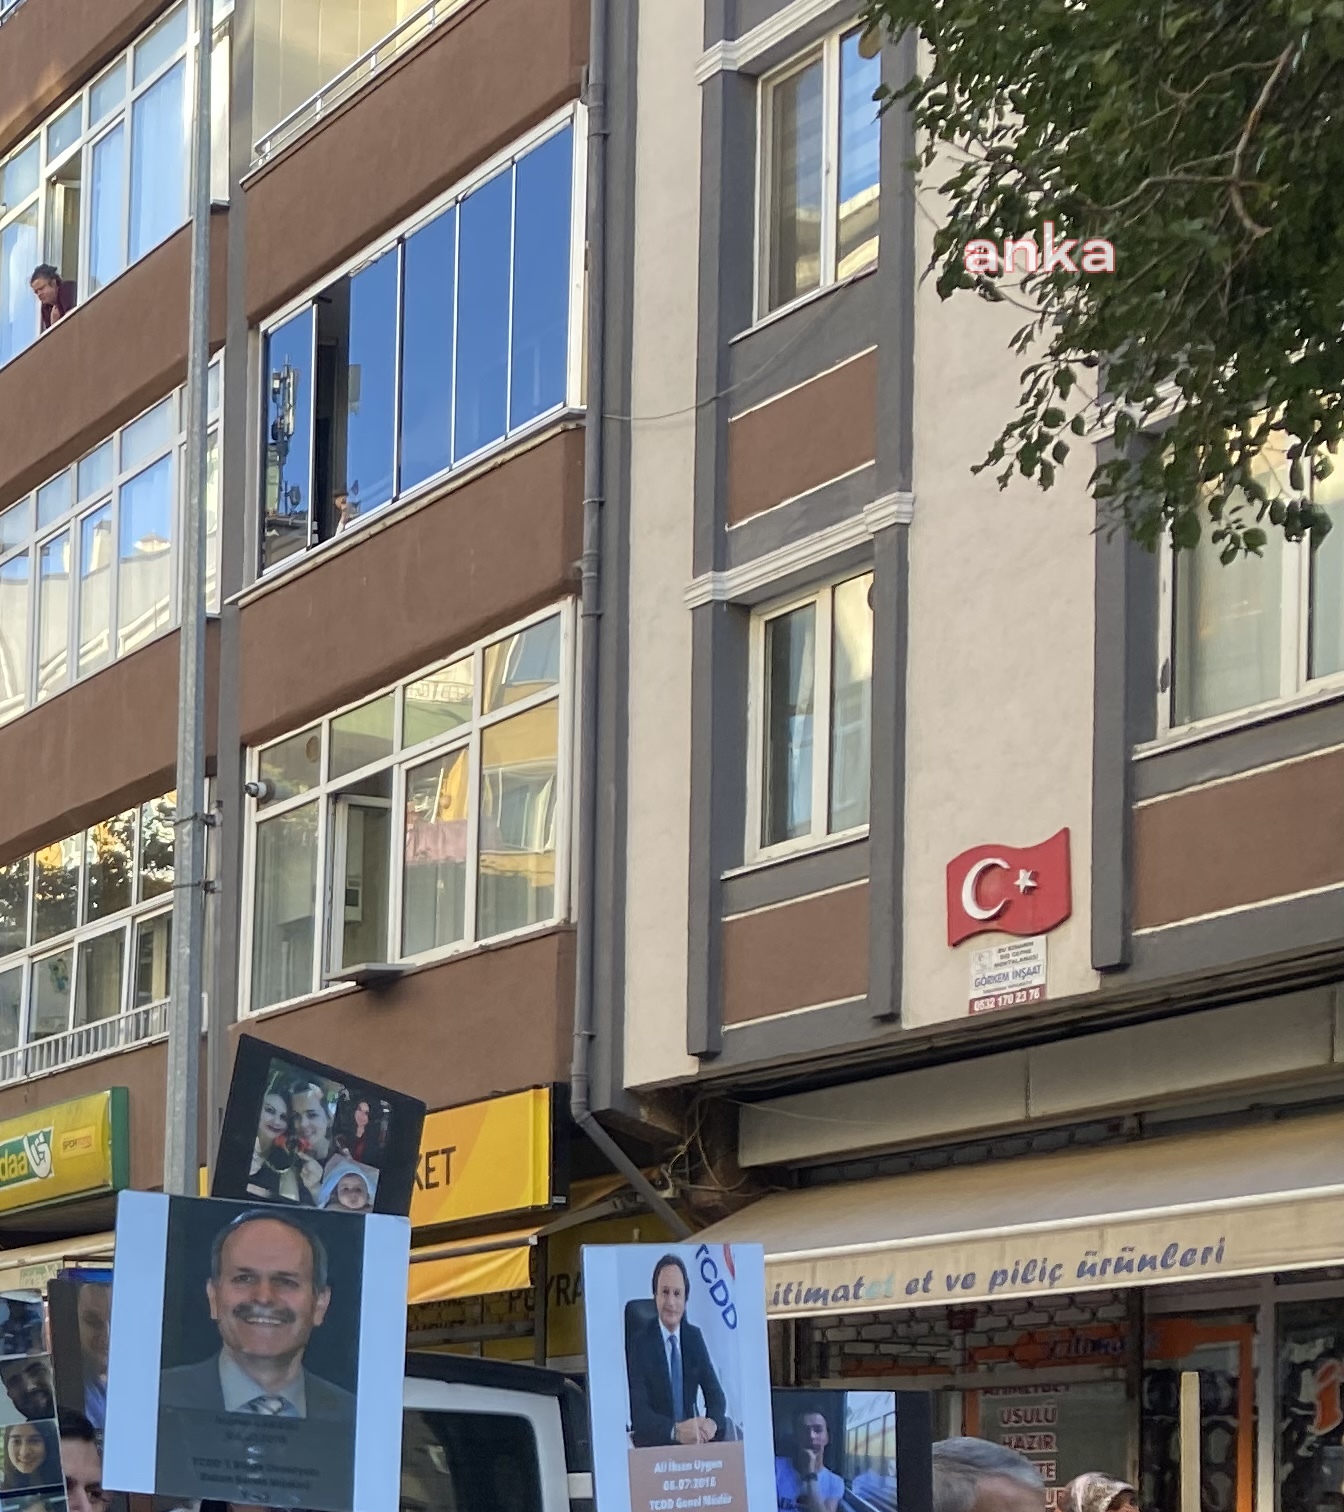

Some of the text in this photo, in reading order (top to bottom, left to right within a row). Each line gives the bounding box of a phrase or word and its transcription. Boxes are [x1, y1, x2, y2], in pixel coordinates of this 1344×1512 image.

[998, 993, 1014, 1007] 170
[1015, 990, 1027, 1004] 23
[904, 1270, 935, 1298] et
[946, 1271, 976, 1292] ve
[988, 1256, 1064, 1295] piliç
[1077, 1236, 1226, 1280] ürünleri
